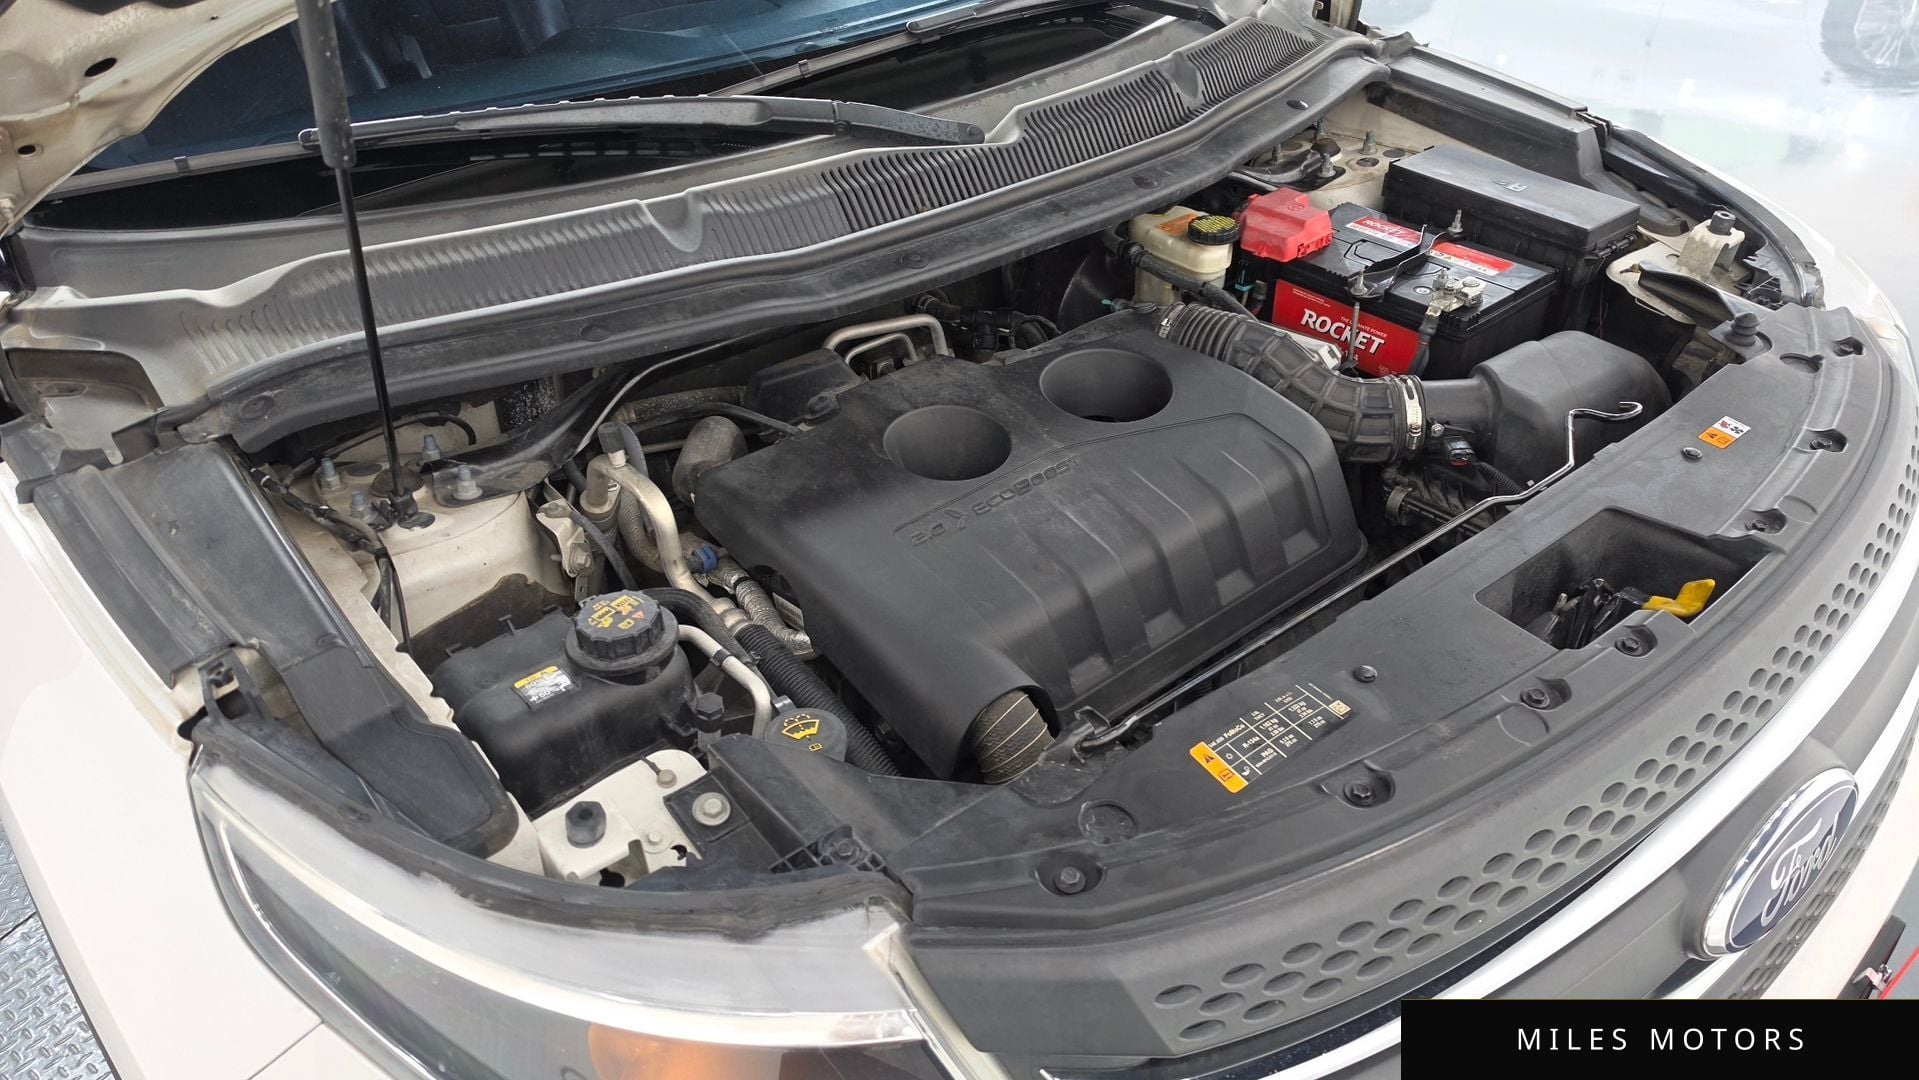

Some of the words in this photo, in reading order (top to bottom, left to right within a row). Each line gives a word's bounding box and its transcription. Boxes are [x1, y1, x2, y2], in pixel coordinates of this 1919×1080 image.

[1300, 309, 1385, 354] ROCKET
[1370, 328, 1387, 338] POWER
[1761, 811, 1840, 926] Ford
